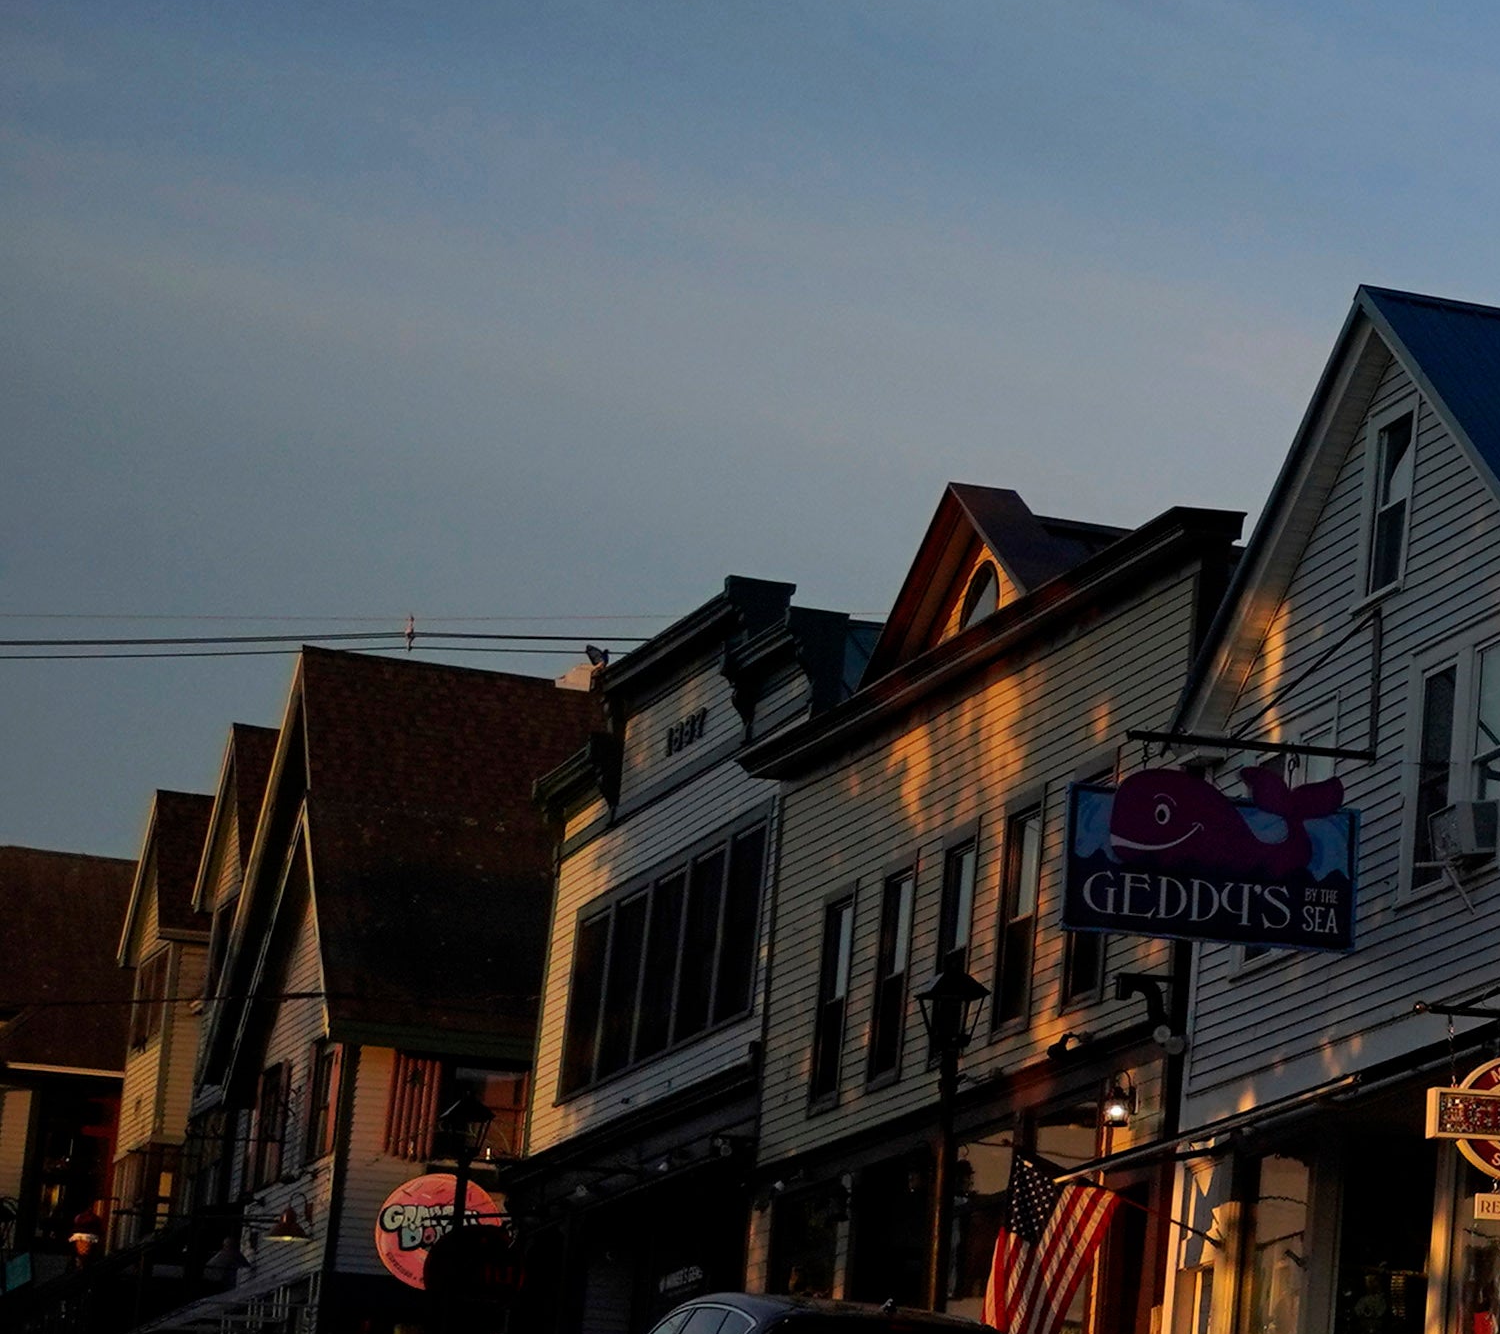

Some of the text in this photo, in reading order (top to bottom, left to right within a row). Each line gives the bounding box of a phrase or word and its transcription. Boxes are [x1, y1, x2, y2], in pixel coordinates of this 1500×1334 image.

[666, 707, 707, 757] 1887
[1081, 870, 1291, 930] GEDDY'S
[1304, 887, 1339, 905] BY THE
[1302, 905, 1339, 935] SEA
